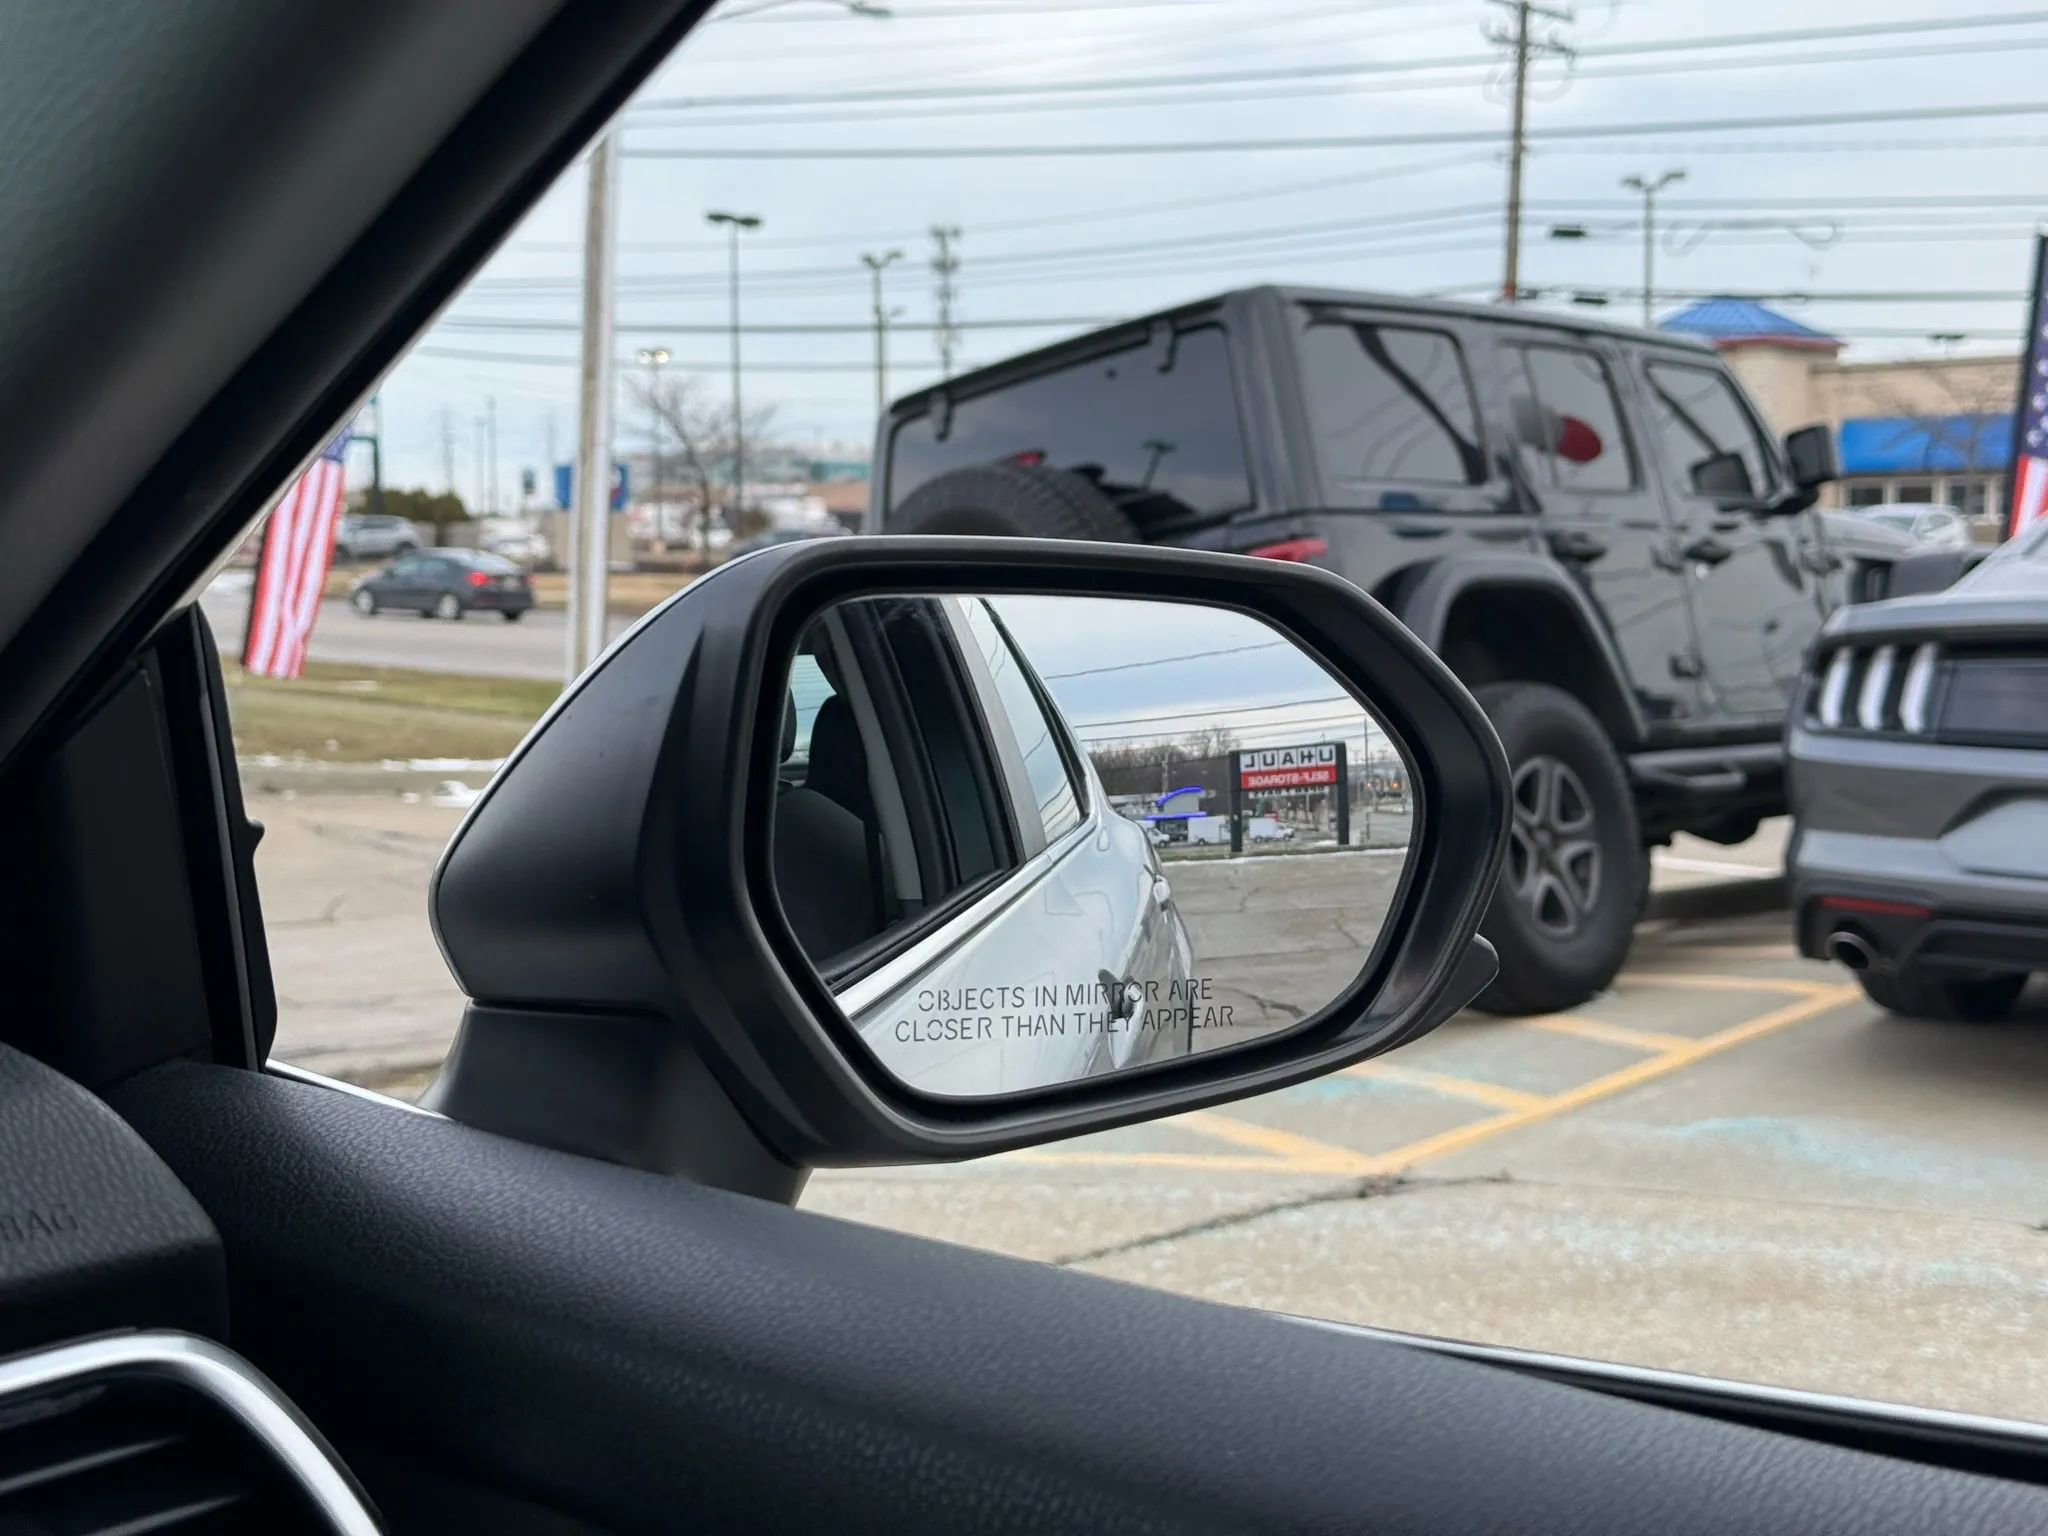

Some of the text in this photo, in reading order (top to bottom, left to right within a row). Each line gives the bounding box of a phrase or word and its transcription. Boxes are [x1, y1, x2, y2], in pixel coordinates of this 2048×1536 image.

[918, 977, 1214, 1012] OBJECTS IN MIRROR ARE
[894, 1005, 1234, 1043] CLOSER THAN THEY APPEAR
